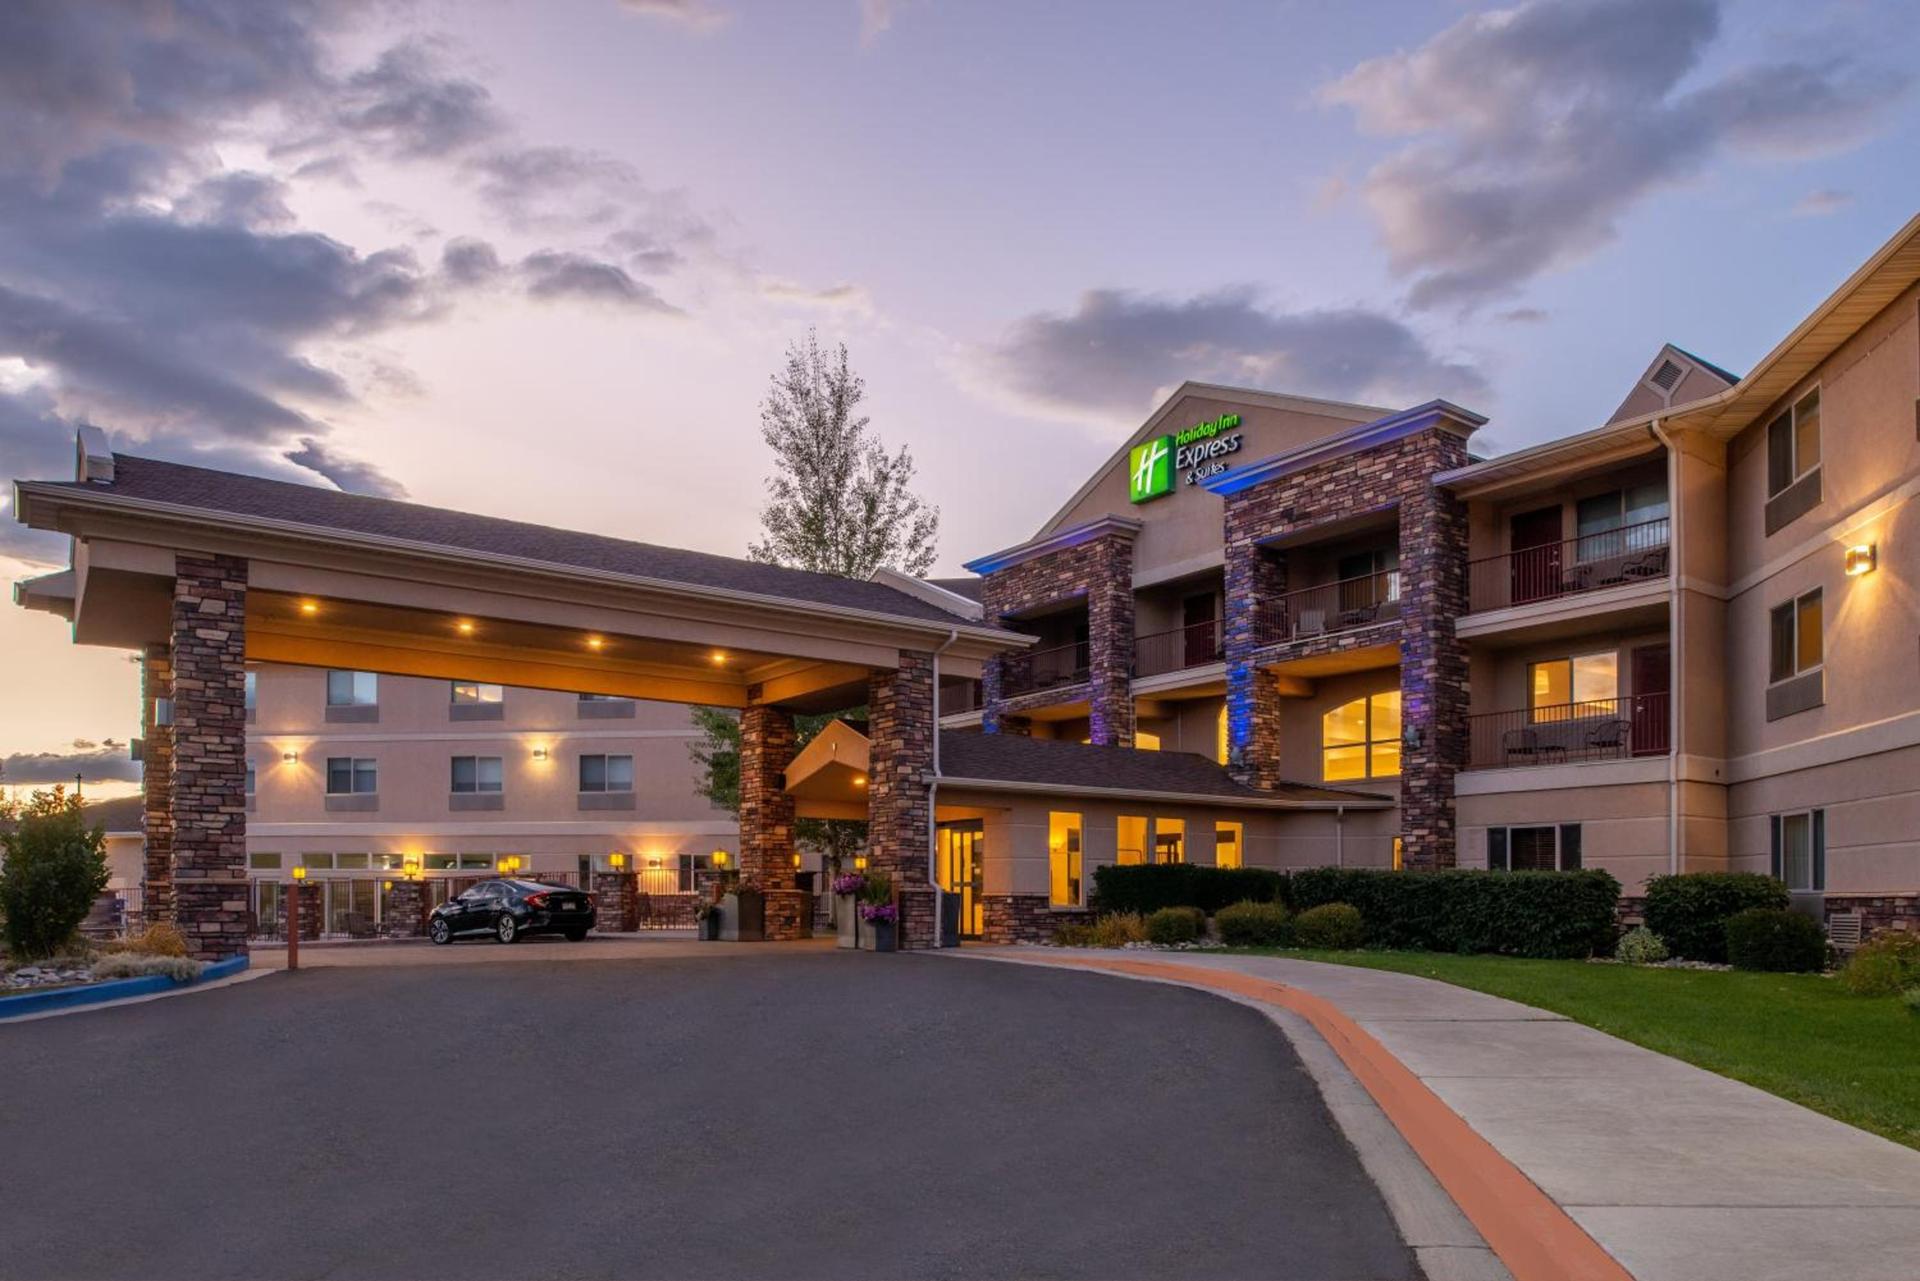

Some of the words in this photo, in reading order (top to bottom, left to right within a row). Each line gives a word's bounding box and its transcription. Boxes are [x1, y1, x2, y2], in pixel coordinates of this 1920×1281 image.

[1176, 421, 1218, 446] Holiday
[1218, 414, 1239, 429] Inn
[1176, 434, 1240, 469] Express
[1186, 473, 1195, 484] &
[1195, 462, 1226, 480] Suites
